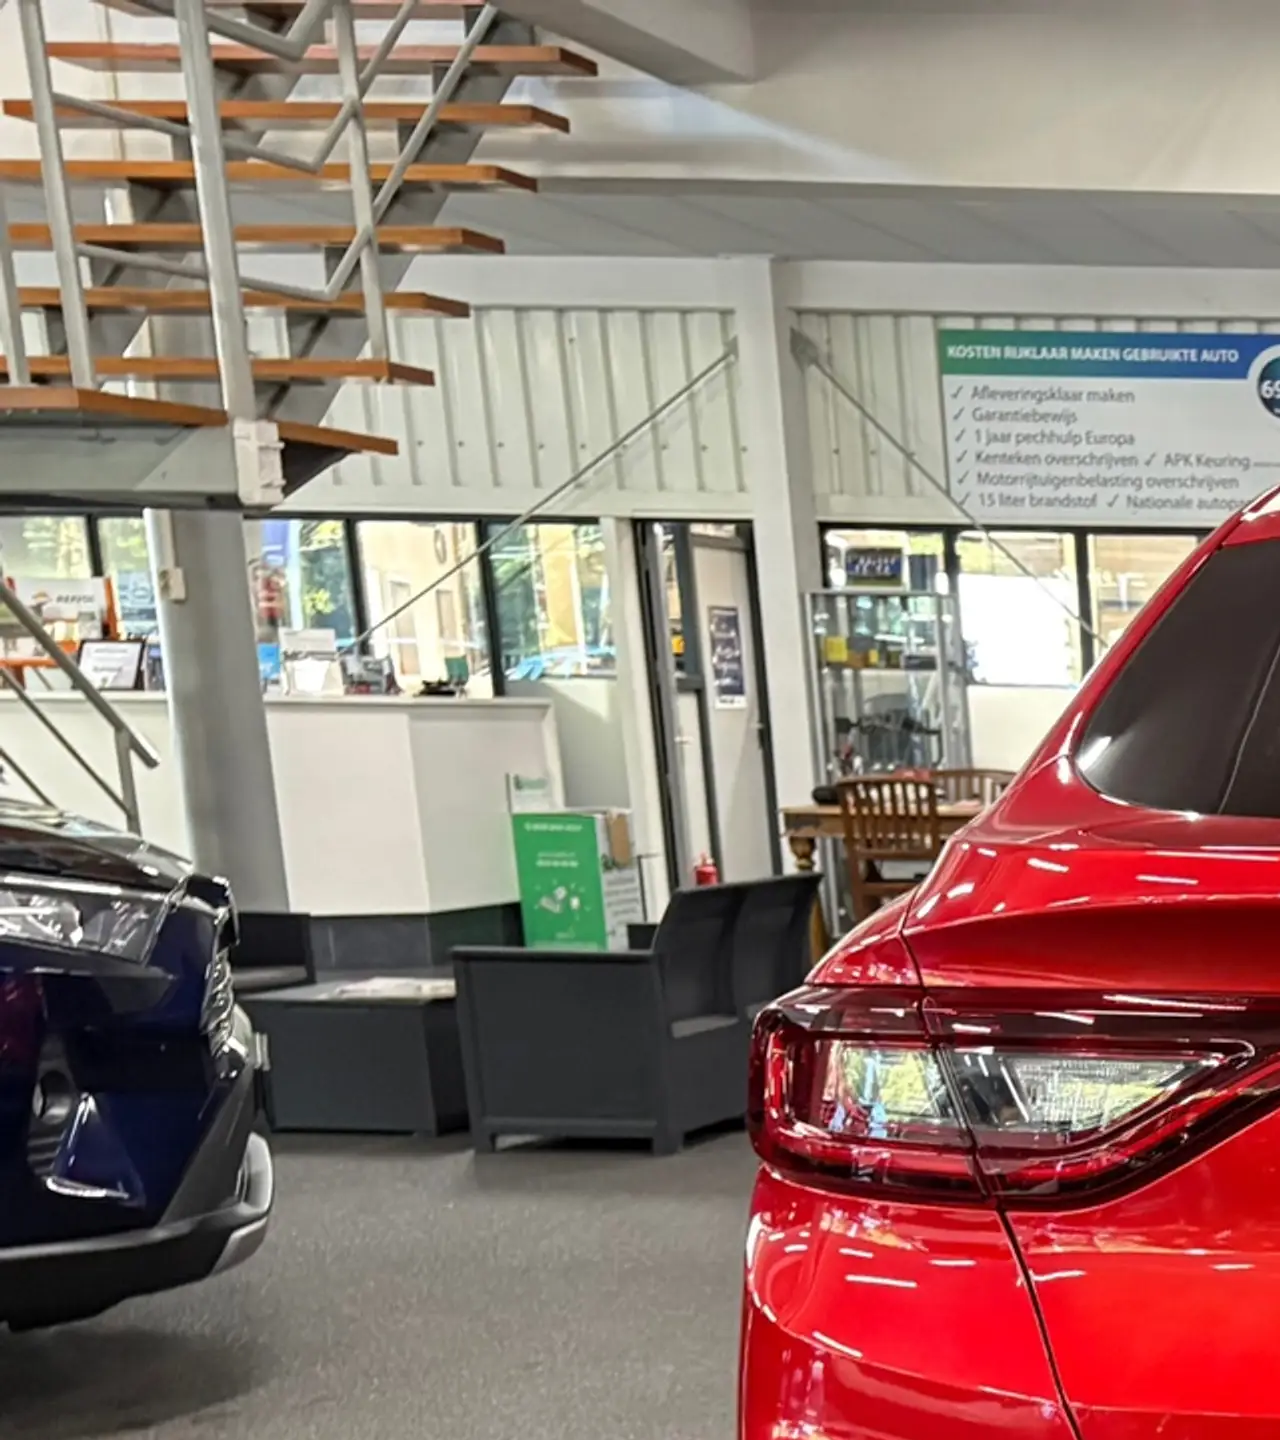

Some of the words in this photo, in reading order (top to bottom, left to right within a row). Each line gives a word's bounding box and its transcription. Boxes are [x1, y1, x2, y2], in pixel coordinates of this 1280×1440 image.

[947, 345, 1000, 360] KOSTEN
[1003, 346, 1069, 361] RIJKLAAR
[1071, 346, 1121, 361] MAKEN
[1122, 347, 1198, 363] GEBRUIKTE
[1200, 348, 1240, 363] AUTO
[970, 384, 1083, 405] Afleveringsklaar
[1086, 387, 1136, 404] maken
[971, 406, 1079, 425] Garantiebewijs
[984, 430, 1013, 447] jaar
[1014, 430, 1083, 448] pechhulp
[1084, 431, 1136, 447] Europa
[974, 451, 1042, 465] Kenteken
[1044, 451, 1139, 469] overschrijven
[1163, 452, 1194, 467] APK
[1195, 453, 1251, 471] Keuring
[976, 471, 1144, 491] Motorrijtuigenbelasting
[1145, 473, 1240, 491] overschrijven
[978, 493, 996, 508] 15
[998, 493, 1027, 508] liter
[1028, 493, 1098, 509] brandstof
[1125, 494, 1194, 510] Nationale
